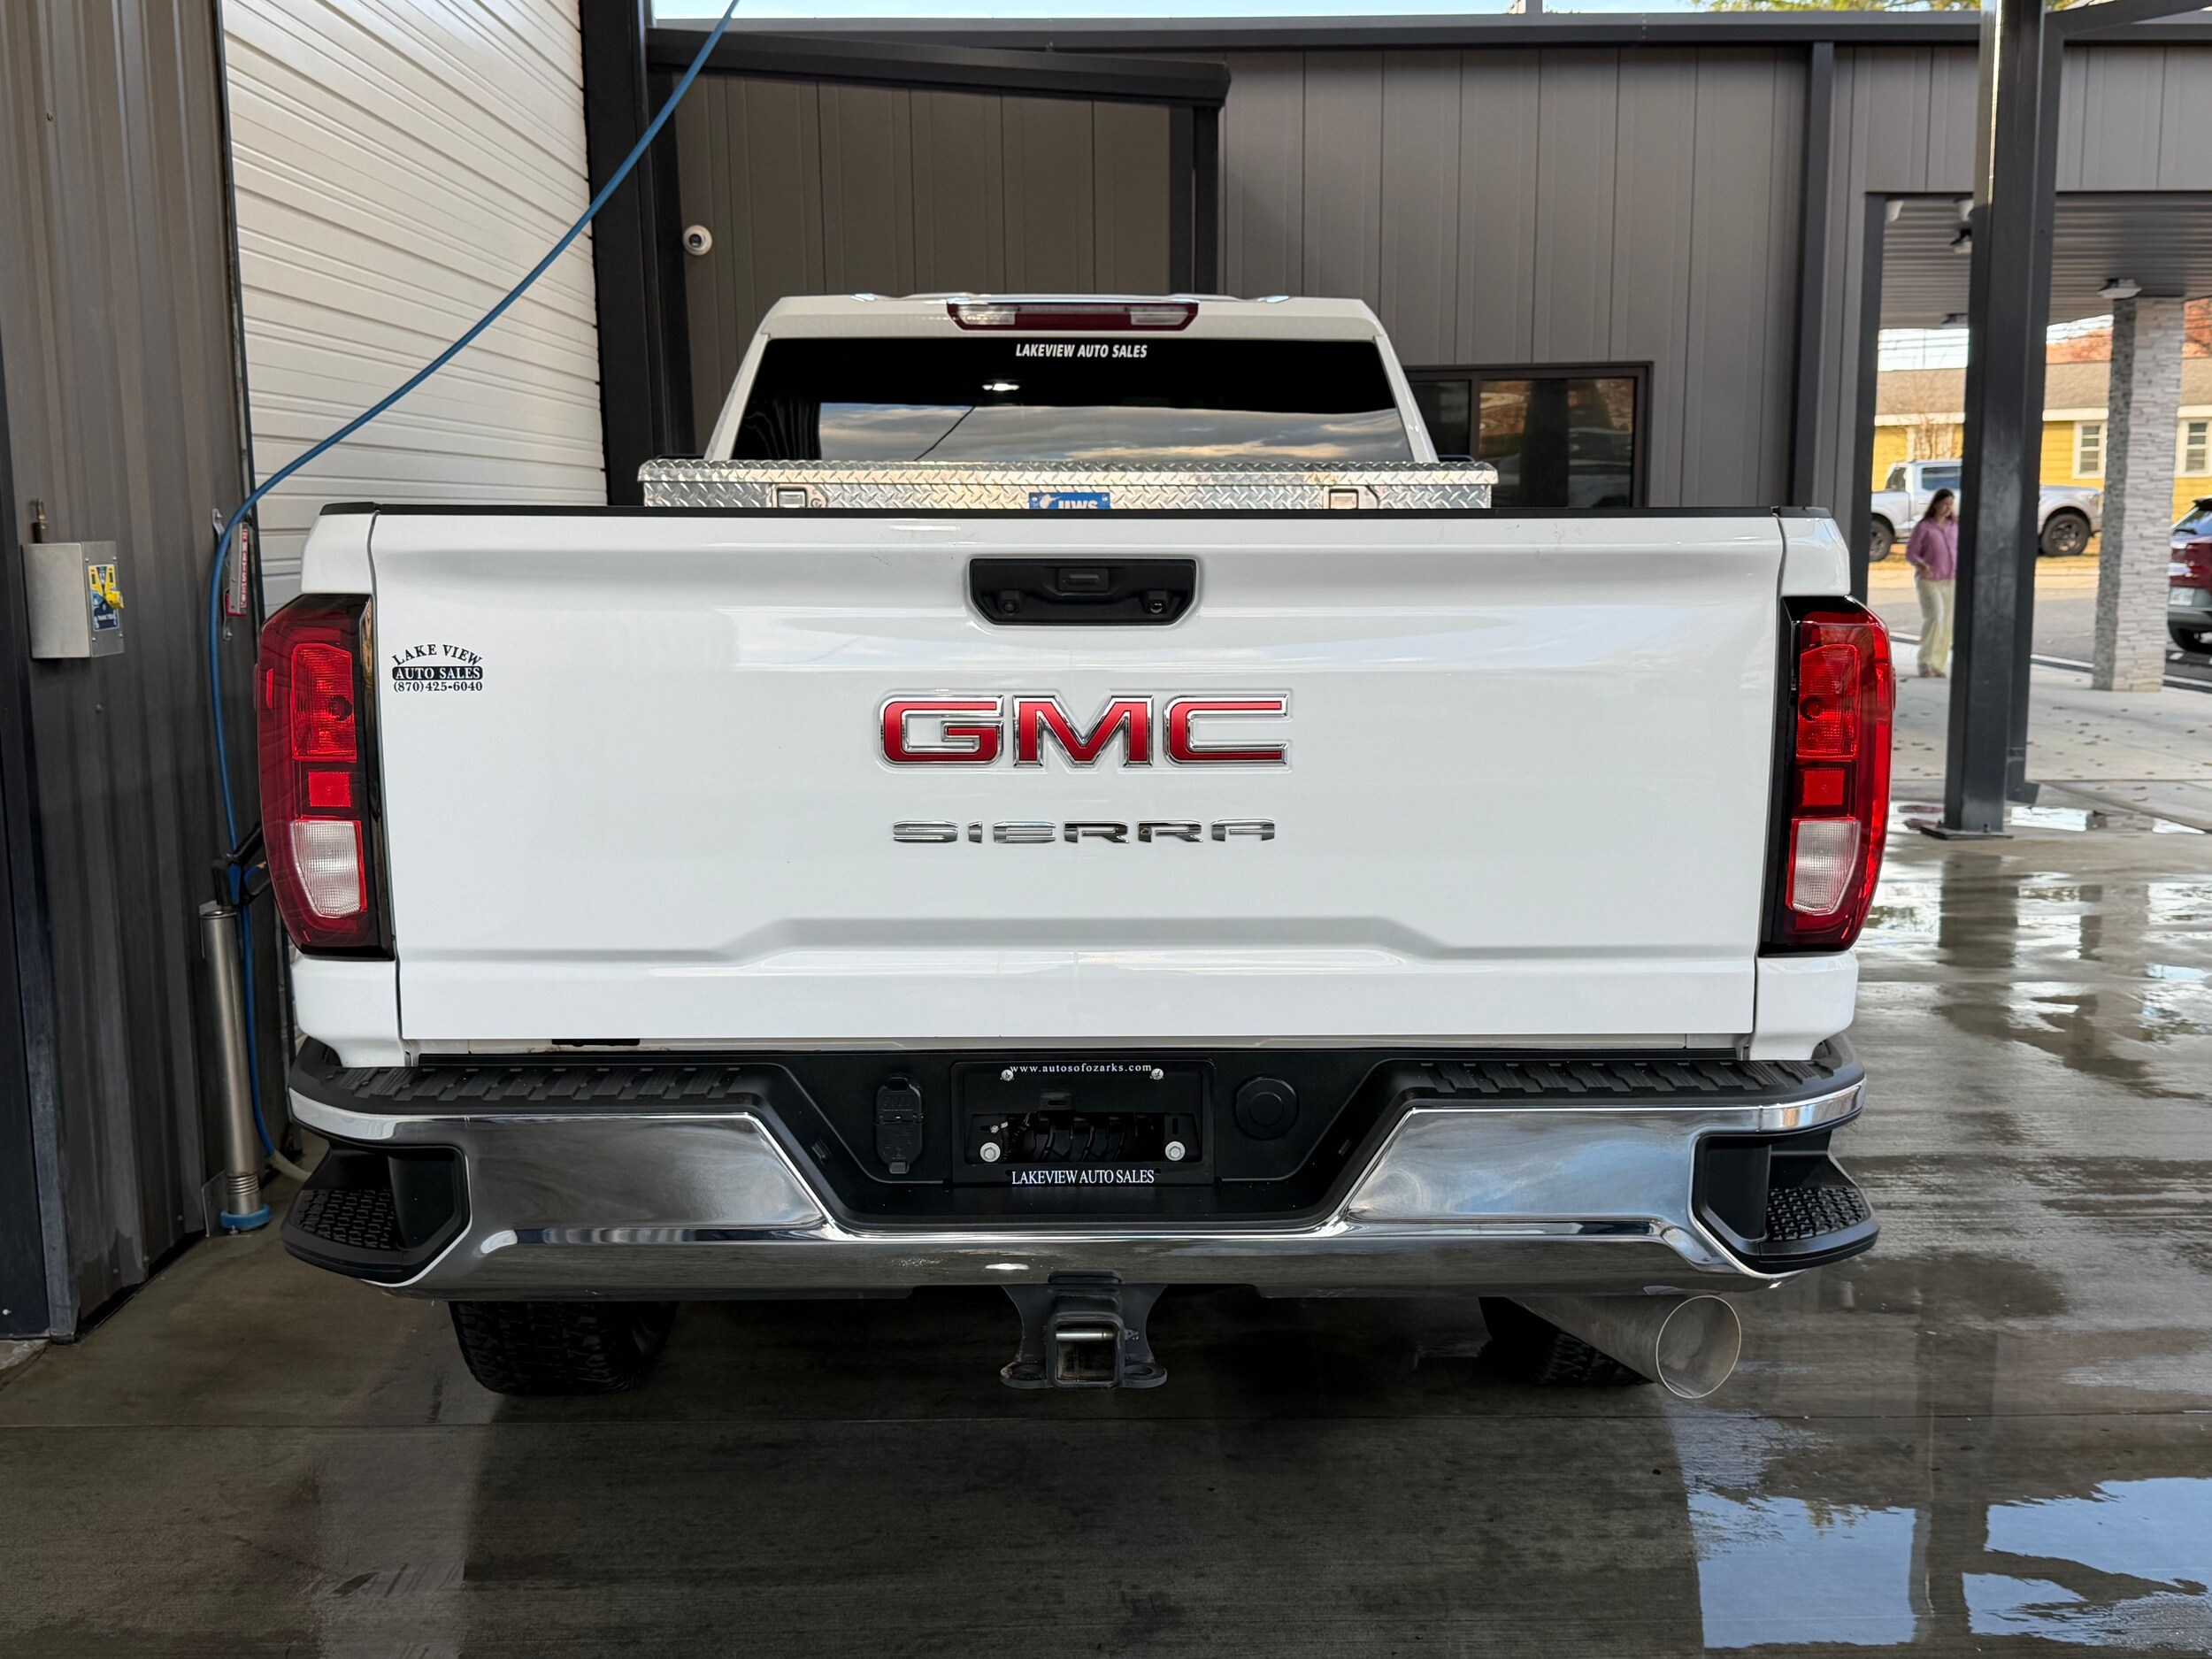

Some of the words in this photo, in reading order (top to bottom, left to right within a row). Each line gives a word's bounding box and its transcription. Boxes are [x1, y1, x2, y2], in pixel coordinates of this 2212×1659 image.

[1016, 343, 1075, 357] LAKEVIEW
[1077, 343, 1109, 358] AUTO
[1111, 344, 1148, 358] SALES
[391, 644, 437, 665] LAKE
[442, 644, 483, 665] VIEW
[396, 667, 435, 680] AUTO
[439, 667, 480, 680] SALES
[879, 695, 1288, 768] GMC
[894, 819, 1276, 843] SIERRA
[1010, 1063, 1152, 1072] www.autosofozarks.com
[1011, 1170, 1078, 1185] LAKEVIEW
[1079, 1170, 1114, 1184] AUTO
[1116, 1169, 1155, 1184] SALES
